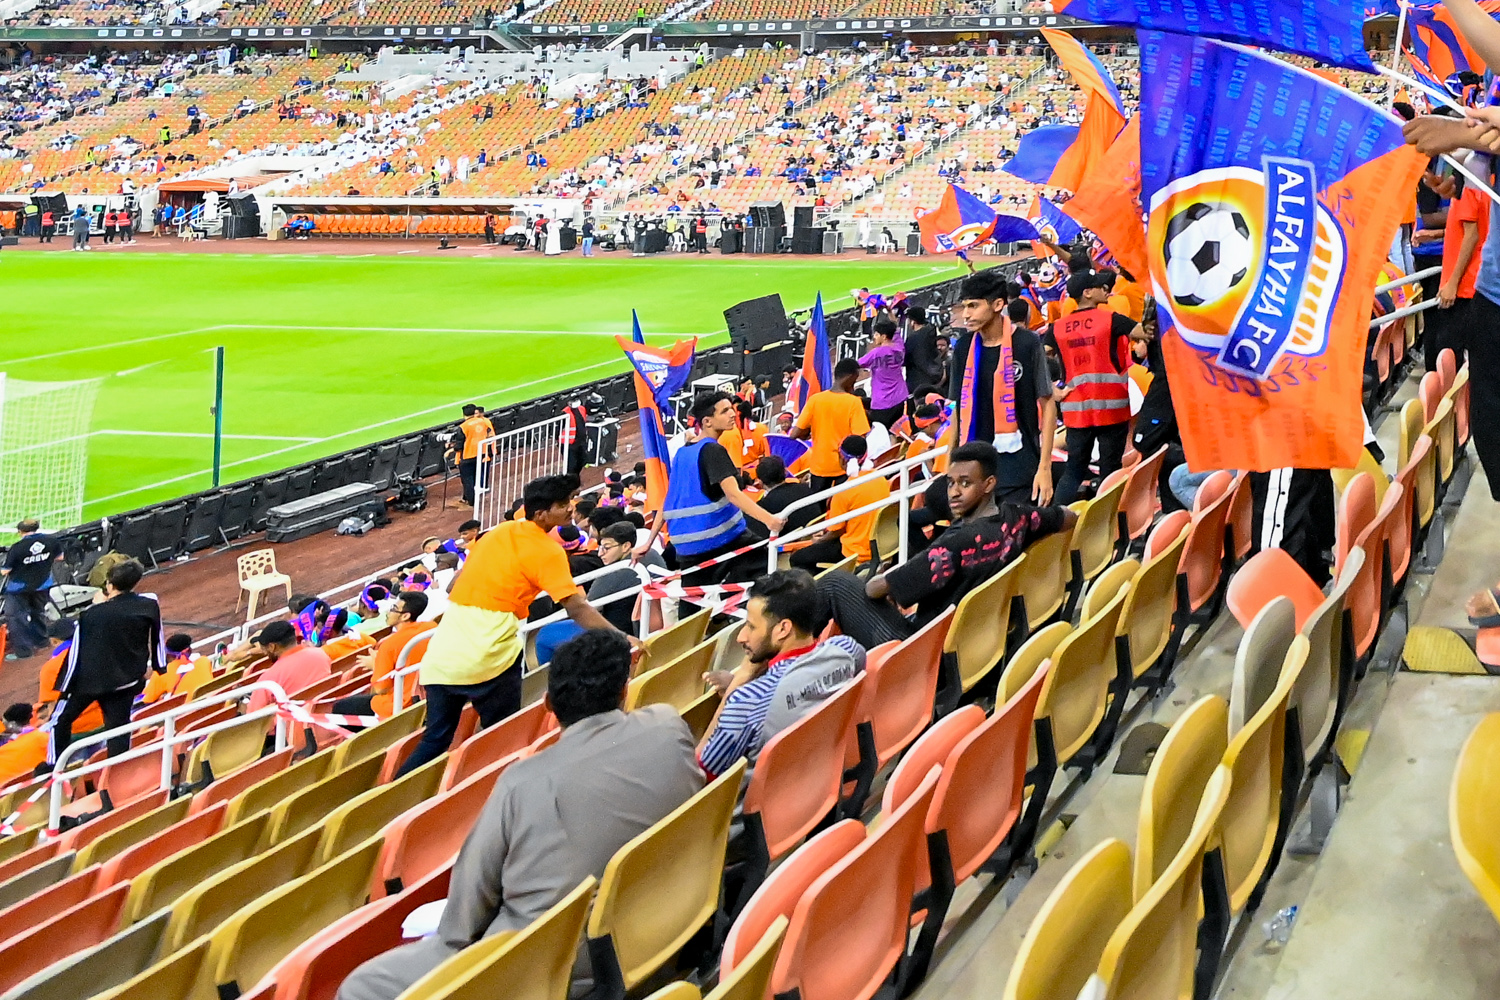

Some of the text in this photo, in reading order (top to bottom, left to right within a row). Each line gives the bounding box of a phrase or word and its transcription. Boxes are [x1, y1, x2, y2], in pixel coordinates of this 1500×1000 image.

[1232, 166, 1305, 369] ALFAYHA FC
[1065, 318, 1093, 333] EPIC
[23, 552, 50, 564] CREW
